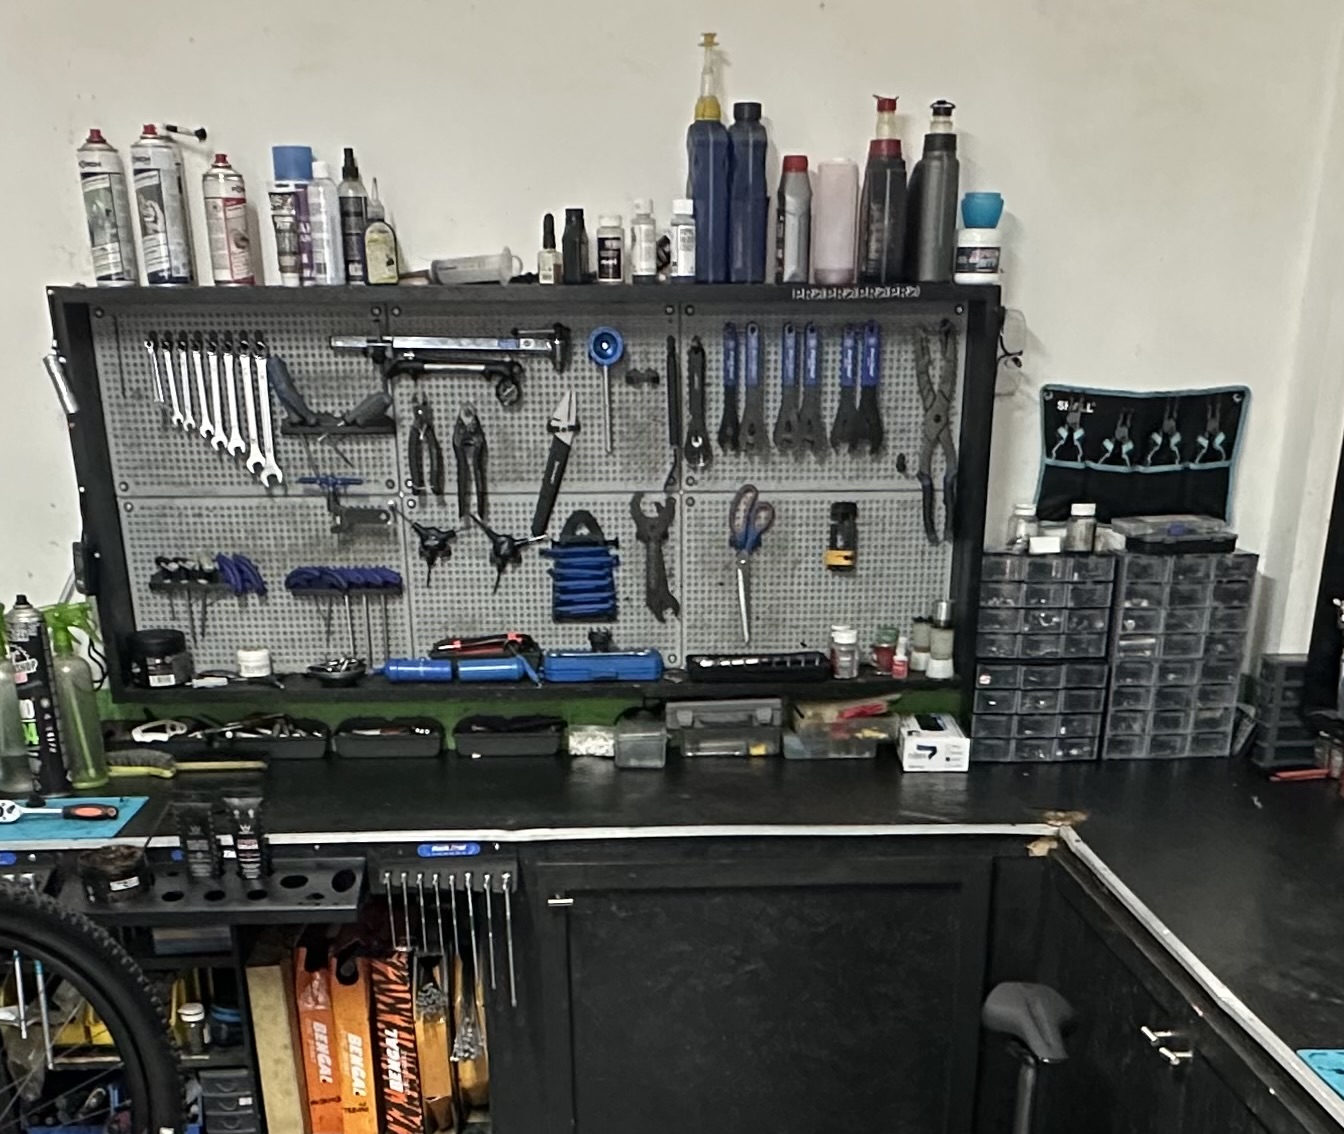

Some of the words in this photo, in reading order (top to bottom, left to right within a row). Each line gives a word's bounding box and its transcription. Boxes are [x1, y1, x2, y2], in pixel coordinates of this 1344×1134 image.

[312, 1020, 334, 1084] BENGAL
[346, 1031, 367, 1097] BENGAL
[384, 1028, 405, 1093] BENGAL
